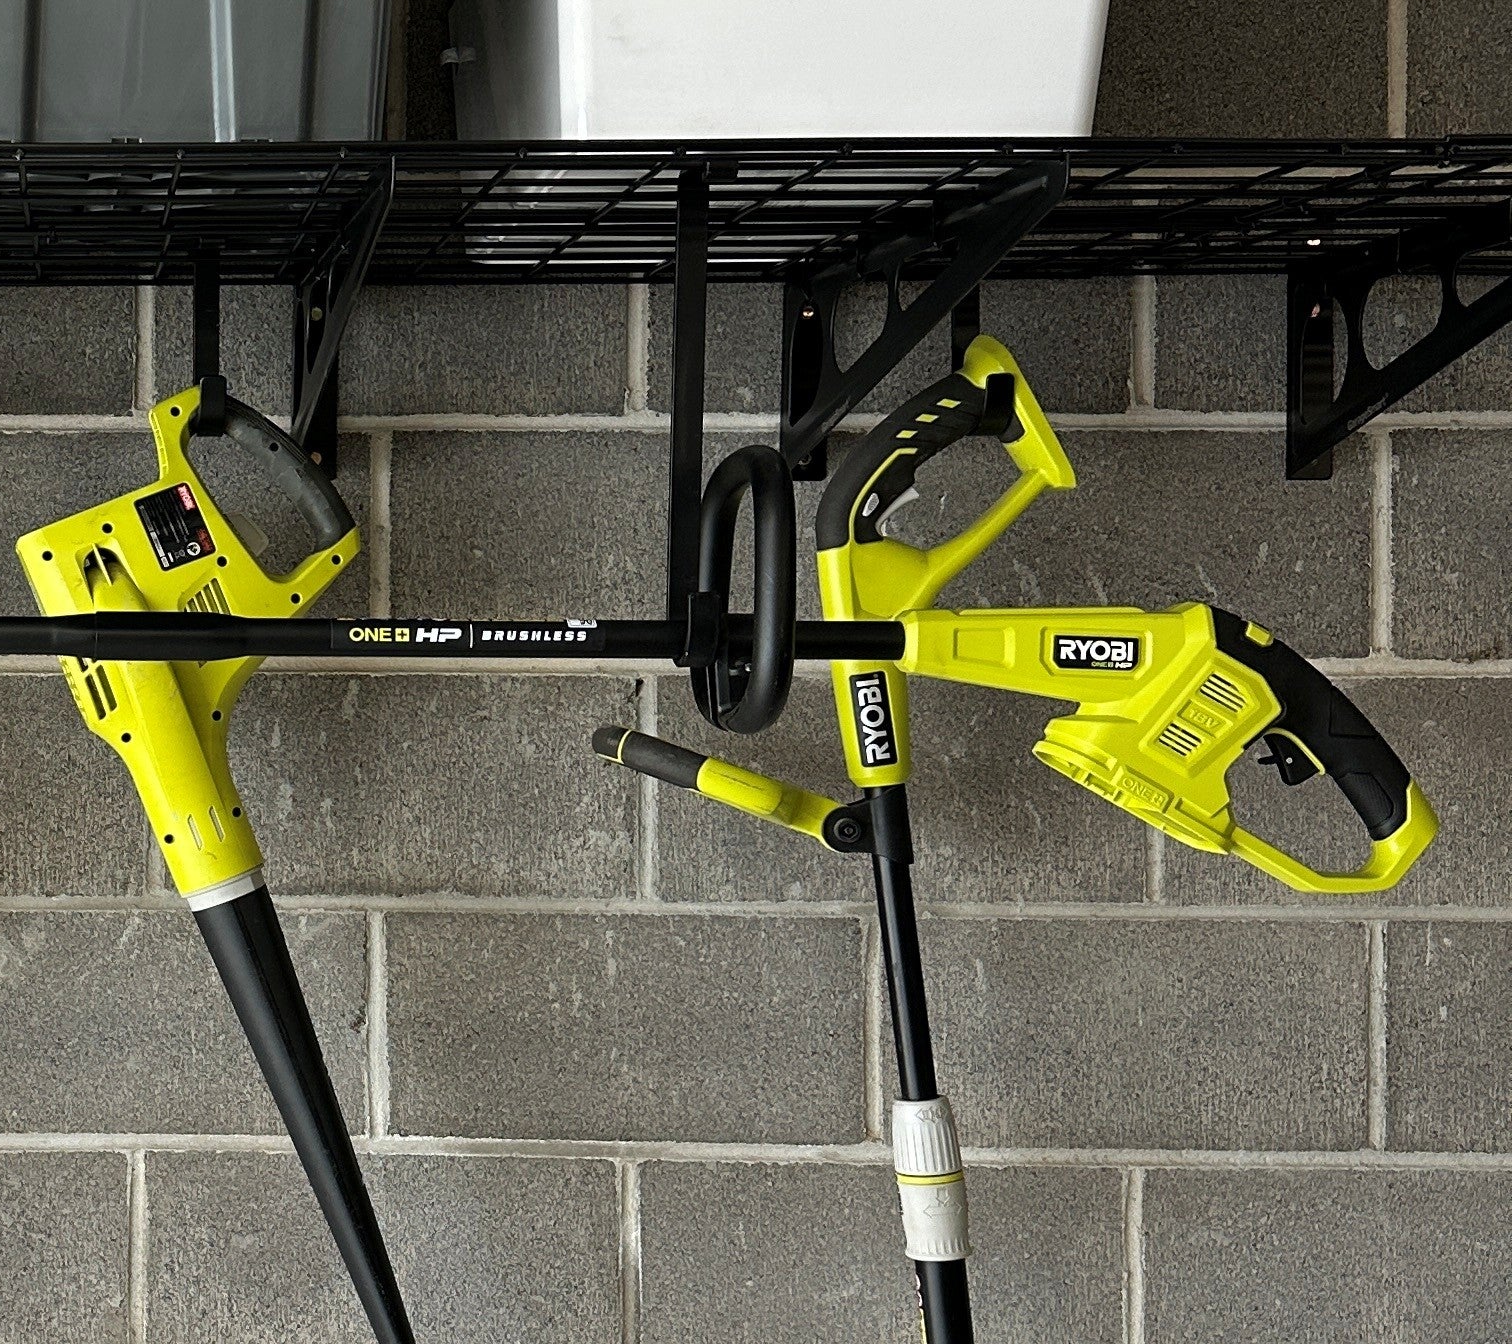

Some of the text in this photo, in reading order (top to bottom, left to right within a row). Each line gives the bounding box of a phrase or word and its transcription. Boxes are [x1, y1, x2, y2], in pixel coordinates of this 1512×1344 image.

[415, 628, 462, 643] HP
[481, 630, 587, 642] BRUSHLESS
[1059, 639, 1134, 662] RYOBI
[855, 678, 891, 764] RYOBI
